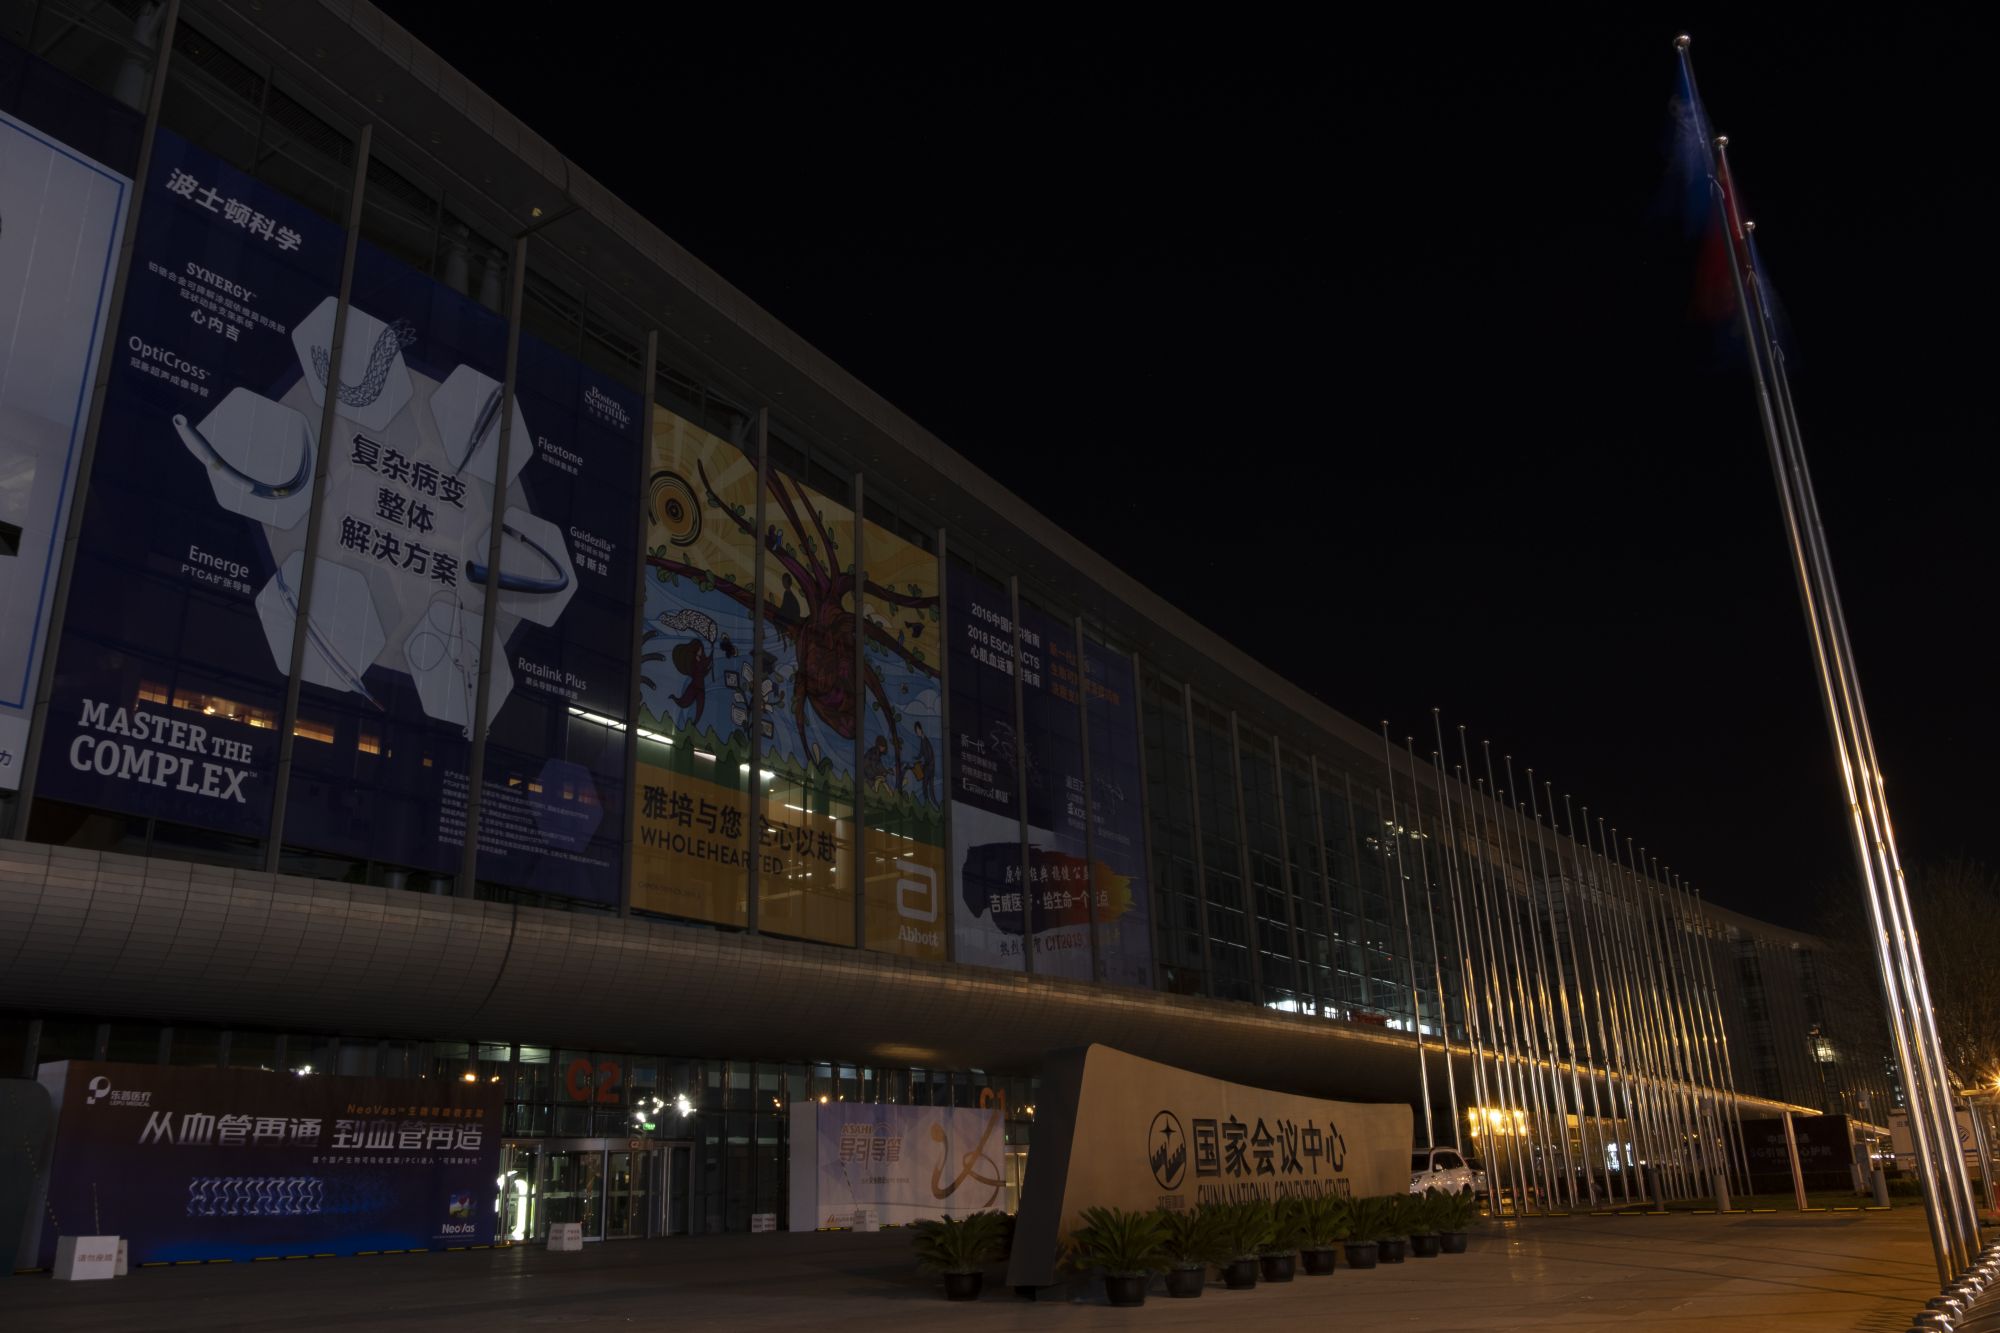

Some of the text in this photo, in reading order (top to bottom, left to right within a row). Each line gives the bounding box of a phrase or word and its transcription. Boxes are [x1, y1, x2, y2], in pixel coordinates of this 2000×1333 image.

[165, 167, 303, 252] 波士顿科学
[186, 261, 253, 303] SYNERGY
[128, 335, 208, 381] OptiCross
[584, 389, 631, 425] Scientific
[591, 385, 621, 411] Boston
[351, 433, 467, 509] 复杂病变
[538, 435, 584, 467] Flextome
[376, 486, 435, 534] 整体
[189, 545, 250, 579] Emerge
[340, 516, 459, 588] 解决方案
[967, 625, 989, 646] 2018
[518, 656, 588, 691] Rotalink Plus
[970, 644, 1041, 689] 心肌血运重指南
[77, 698, 253, 765] MASTER THE
[69, 734, 251, 804] COMPLEX
[642, 785, 743, 840] 雅培与您
[640, 825, 784, 876] WHOLEHEARED
[897, 924, 940, 948] Abbott
[567, 1058, 620, 1103] C2
[138, 1110, 484, 1151] 从血管再通 到血管再造
[841, 1124, 873, 1135] ASAHI
[1192, 1114, 1347, 1179] 国家会议中心
[1198, 1183, 1226, 1204] CHINA
[1229, 1182, 1271, 1203] NATIONAL
[1325, 1176, 1351, 1200] CENTER
